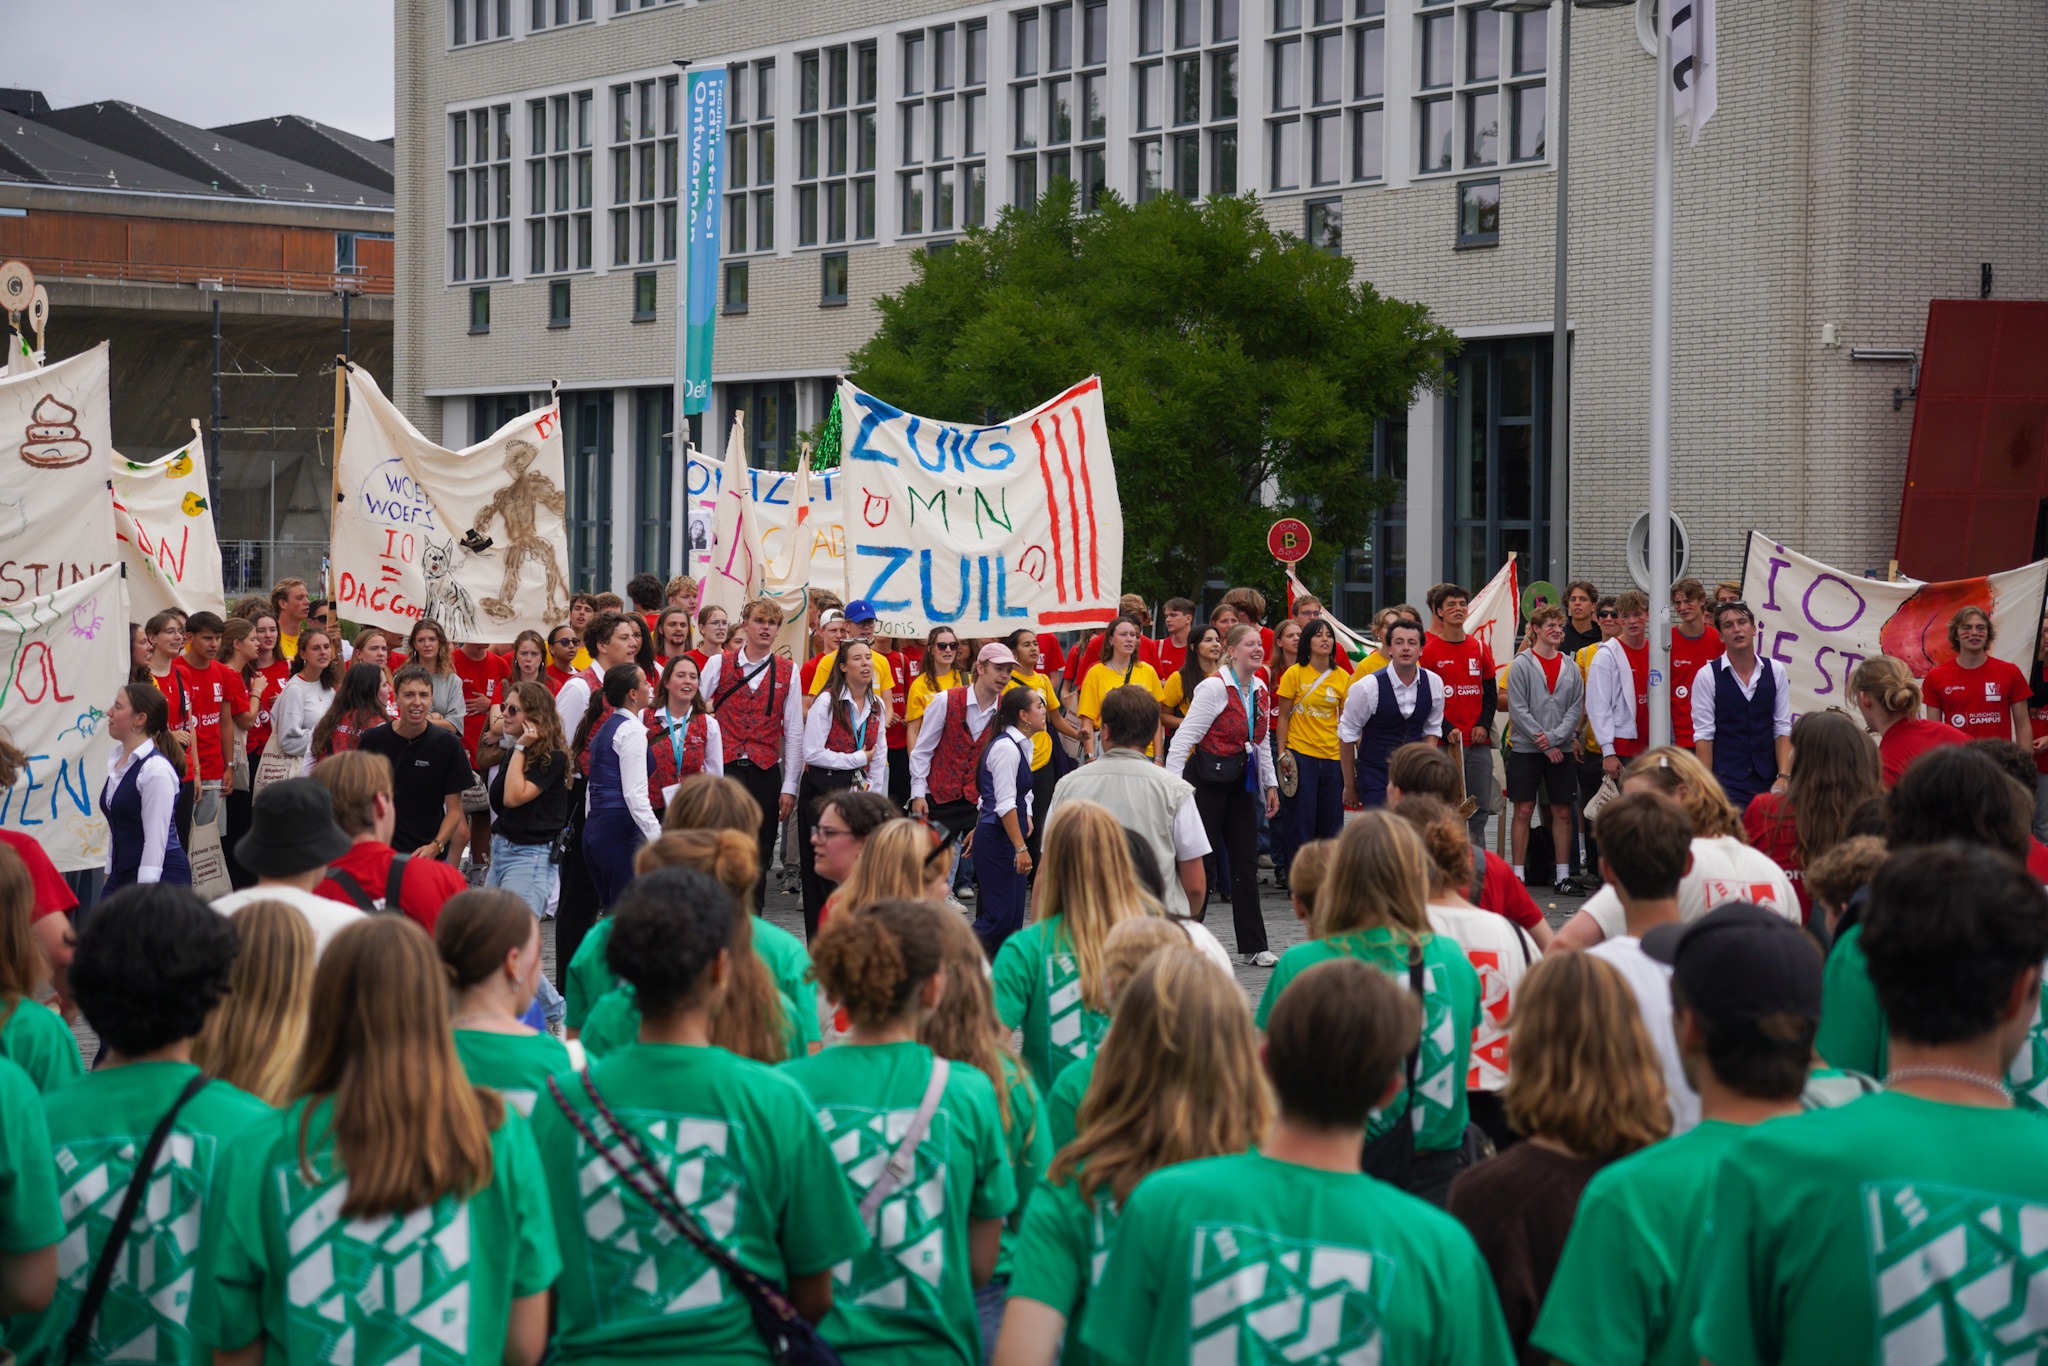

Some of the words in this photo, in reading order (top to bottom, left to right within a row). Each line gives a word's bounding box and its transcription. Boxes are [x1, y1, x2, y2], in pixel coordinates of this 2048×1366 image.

[850, 393, 1016, 473] ZUIG
[366, 493, 422, 523] WOEF
[1284, 531, 1298, 549] B
[856, 544, 1028, 624] ZUIL
